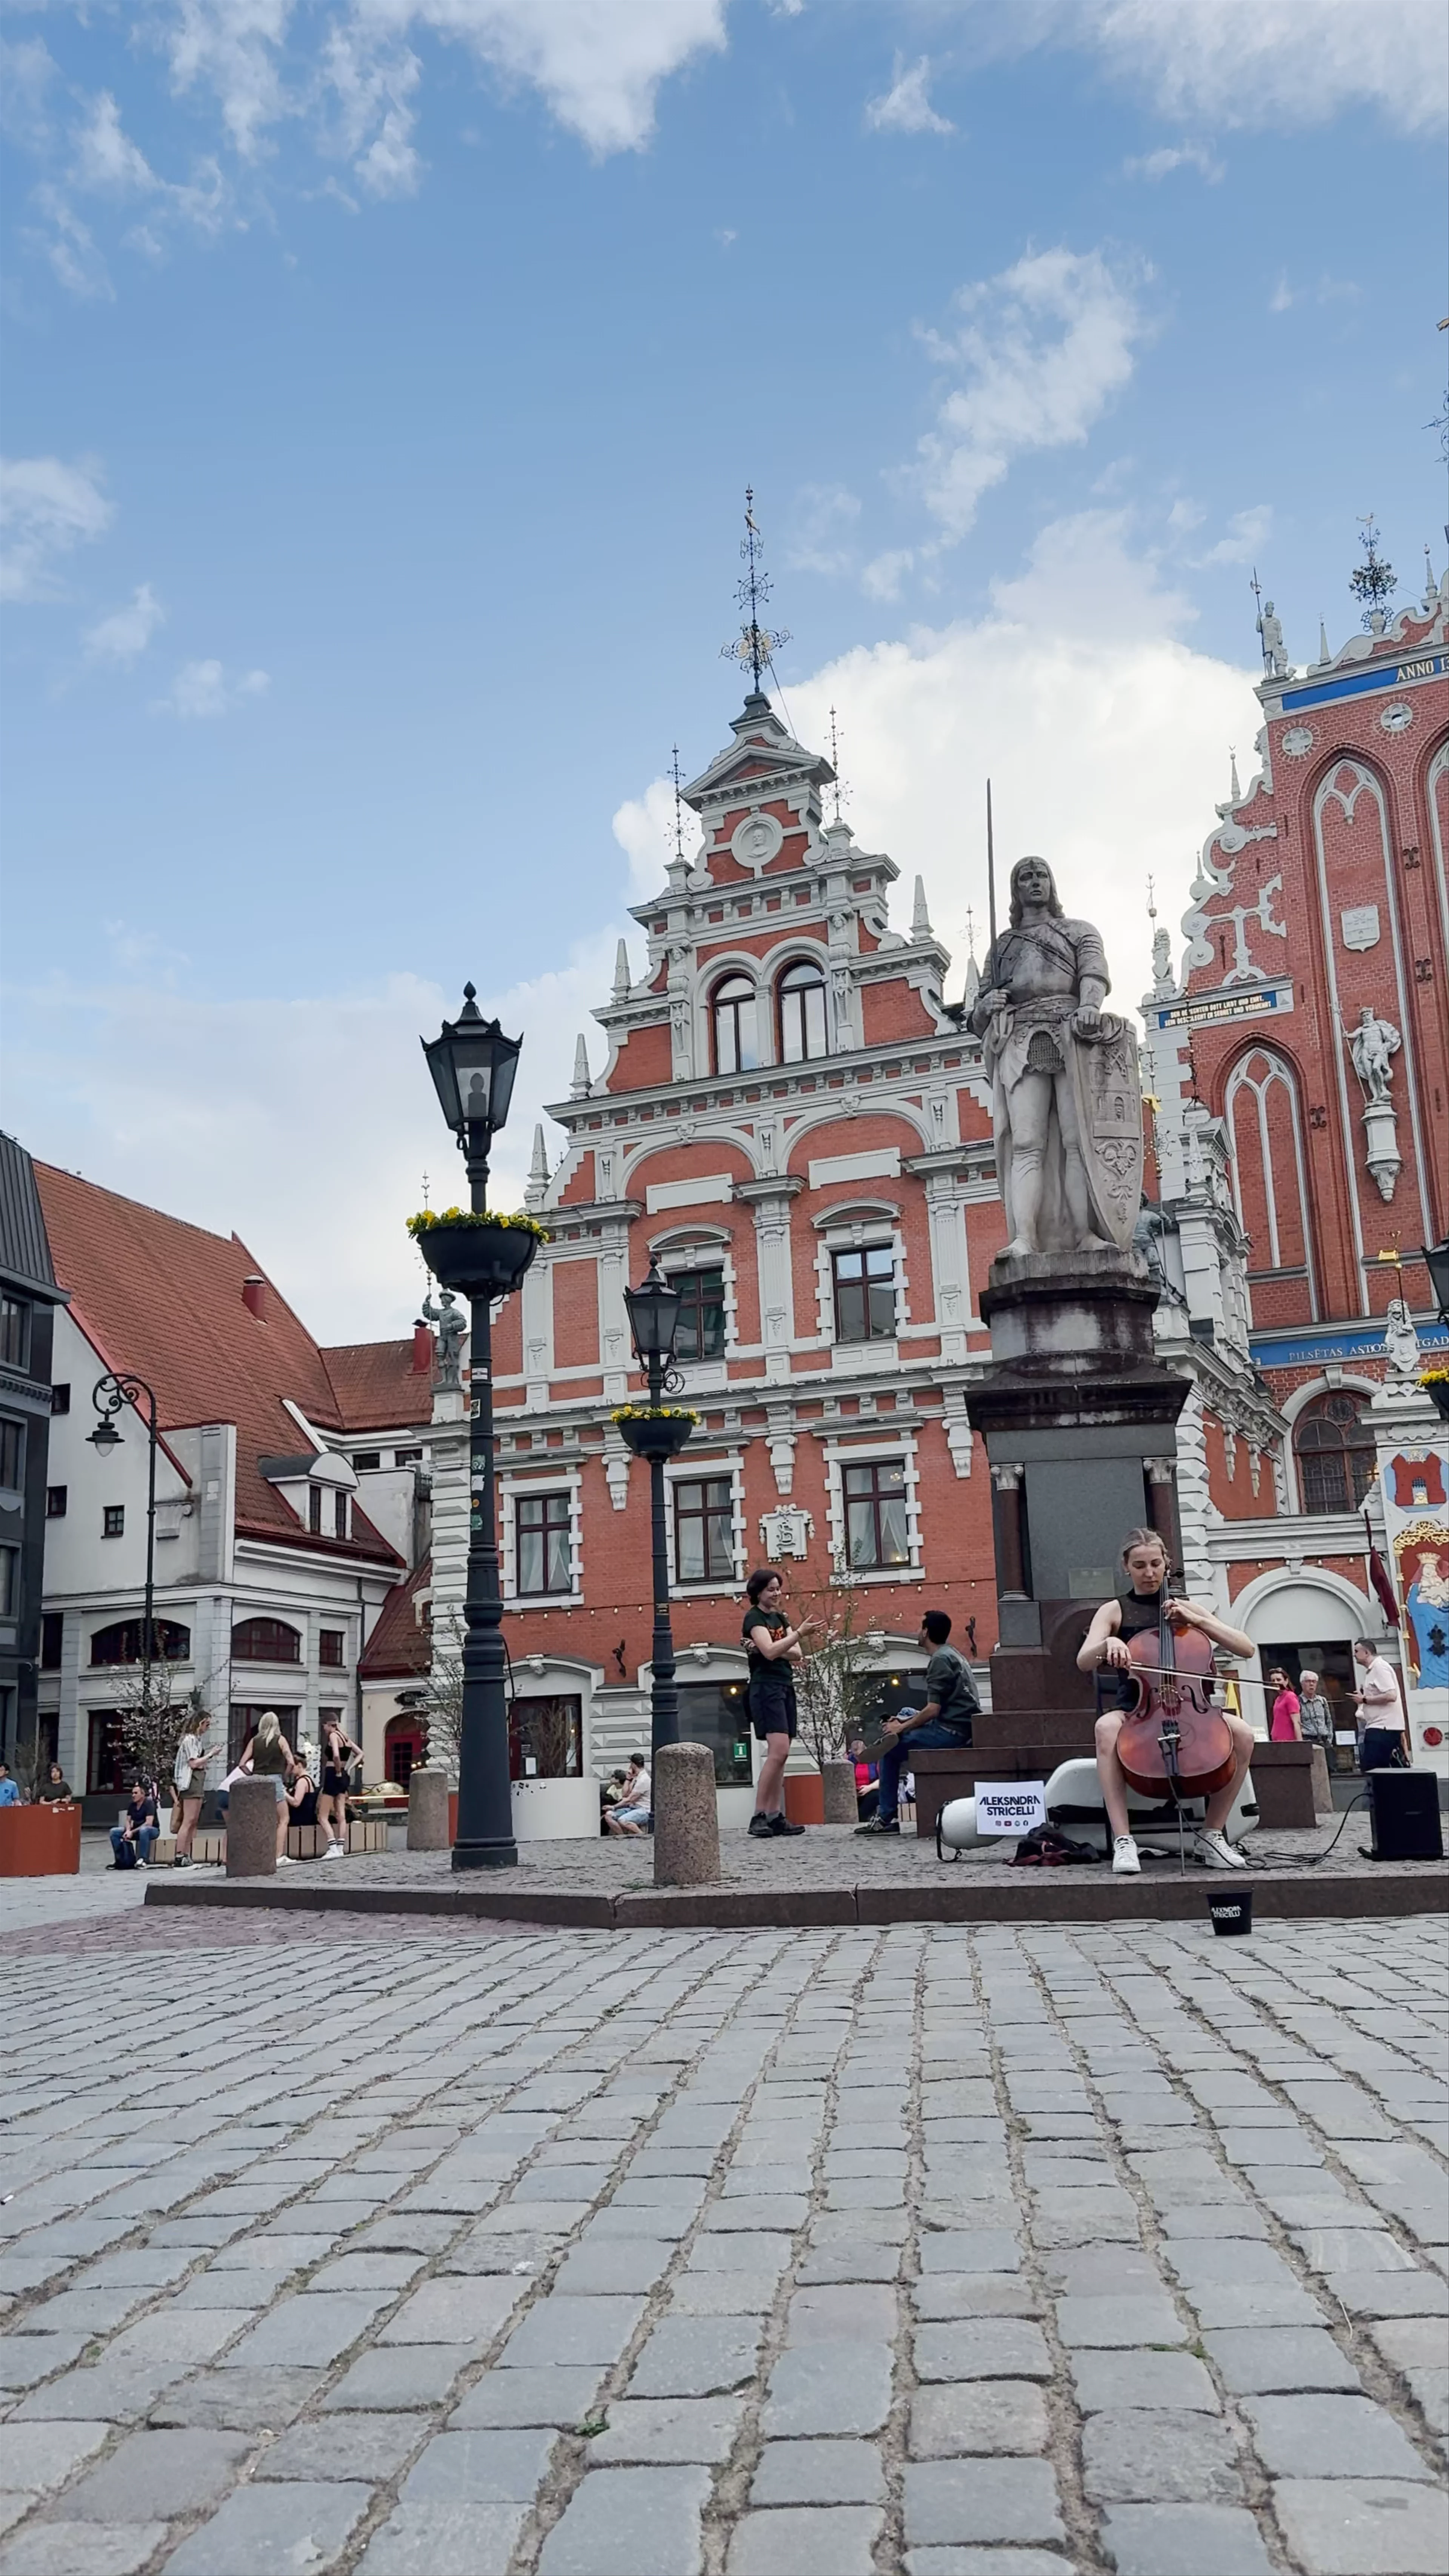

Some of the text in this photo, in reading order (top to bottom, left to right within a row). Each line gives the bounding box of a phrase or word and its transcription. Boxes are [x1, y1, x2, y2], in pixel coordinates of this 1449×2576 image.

[1395, 660, 1434, 682] ANNO
[979, 1795, 1041, 1806] ALEKSANDRA
[987, 1806, 1035, 1816] STRICELLI
